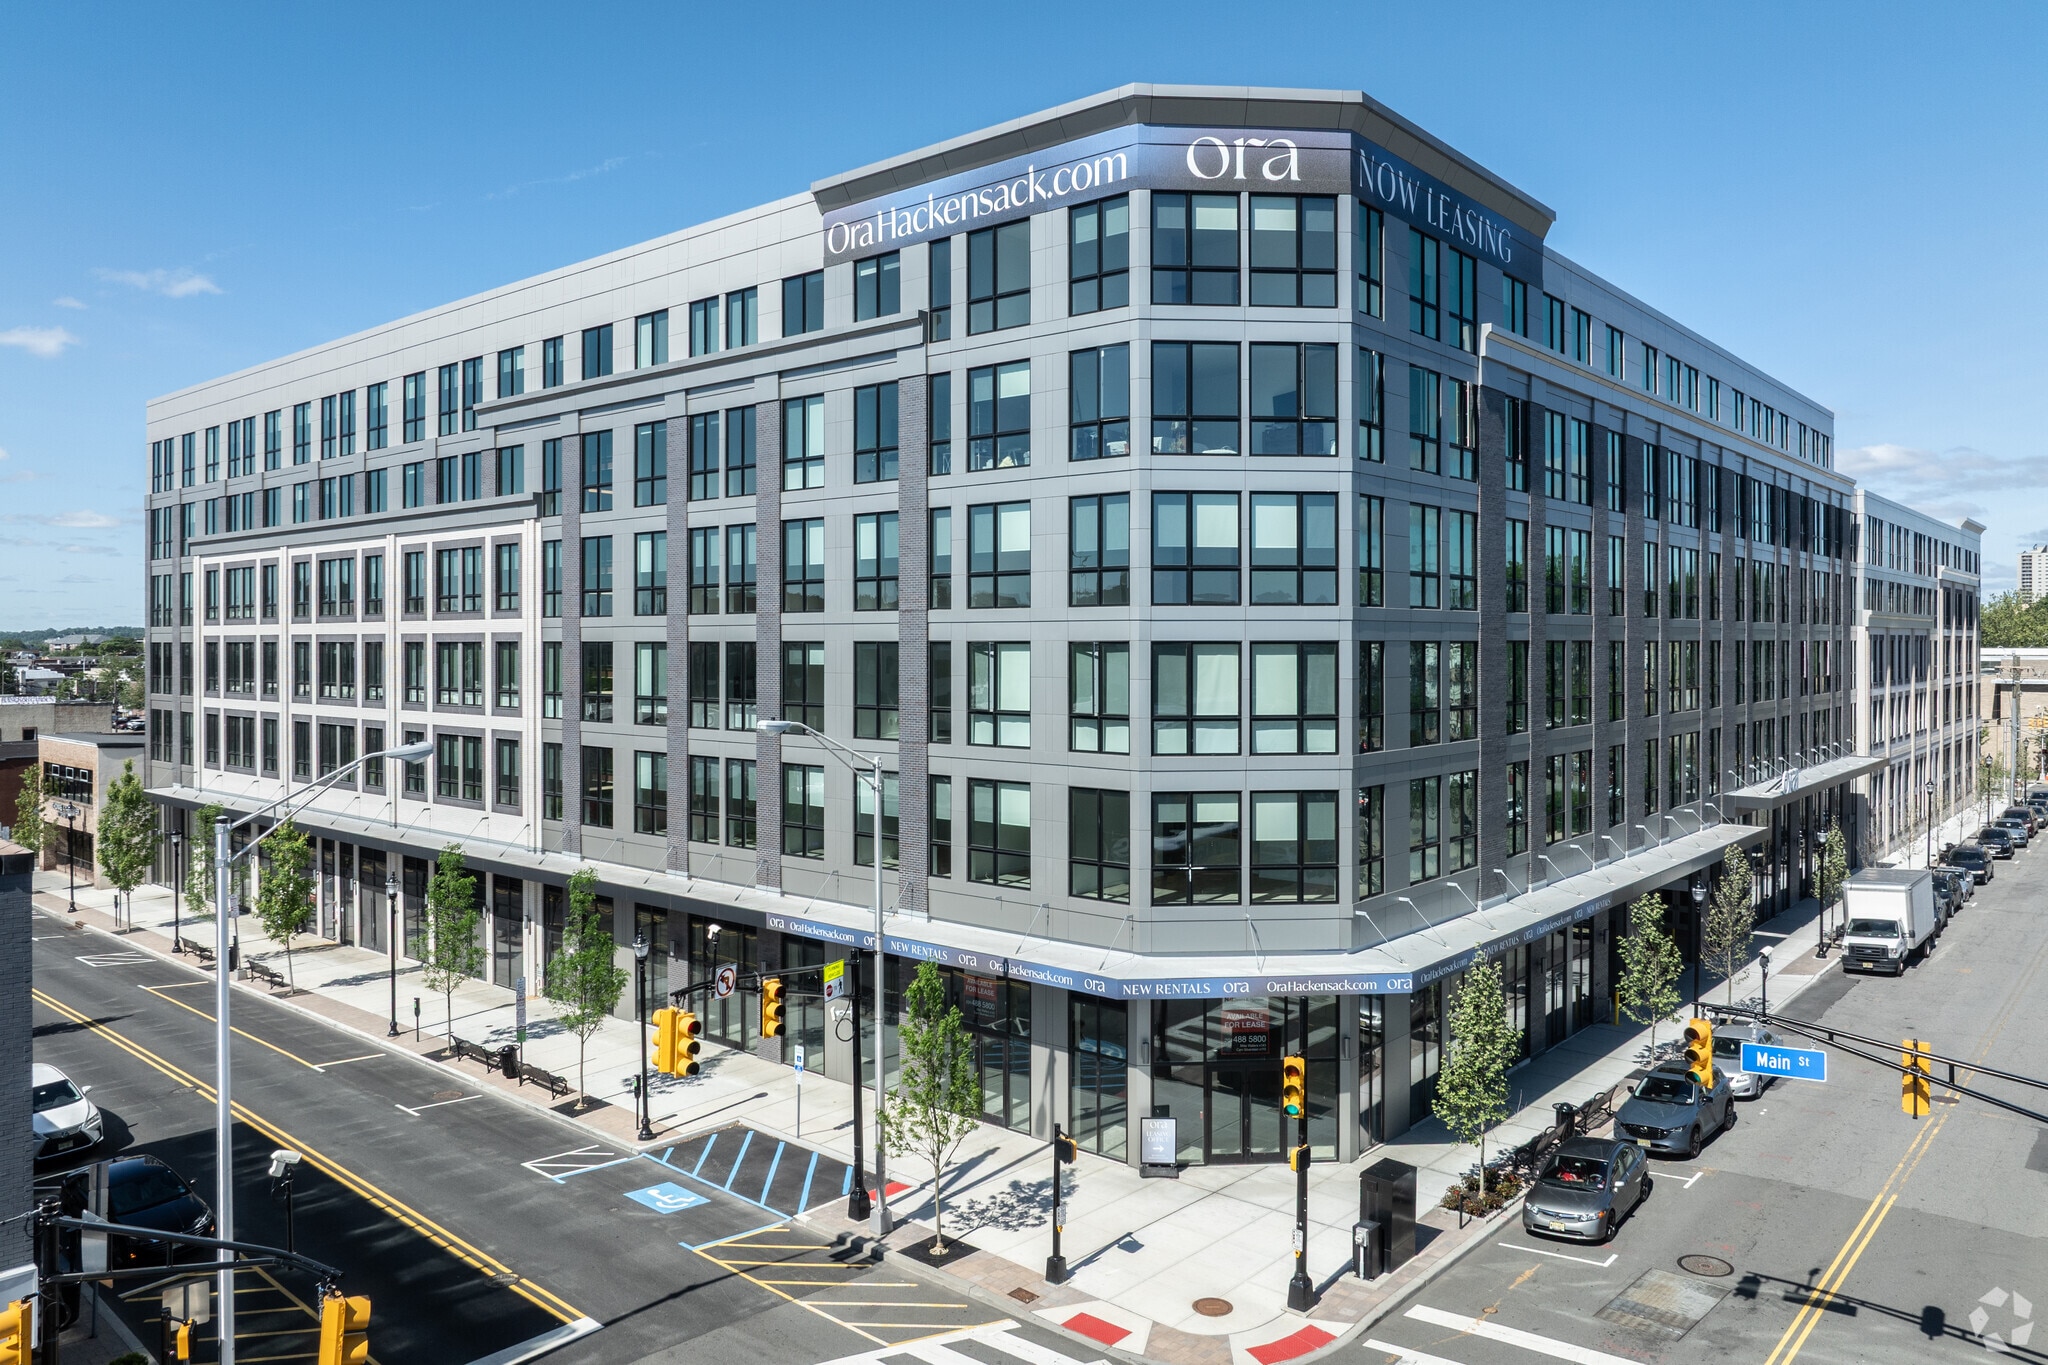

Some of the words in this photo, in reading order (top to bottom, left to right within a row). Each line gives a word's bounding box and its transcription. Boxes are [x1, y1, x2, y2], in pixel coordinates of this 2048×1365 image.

[1186, 136, 1301, 181] ora
[1359, 149, 1420, 215] NOW
[1427, 187, 1512, 264] LEASING
[769, 917, 785, 930] ora
[863, 935, 876, 947] or
[890, 940, 910, 952] NEW
[911, 944, 948, 960] RENTALS
[958, 953, 977, 967] ora
[1084, 978, 1105, 992] ora
[1122, 984, 1152, 995] NEW
[1155, 982, 1211, 994] RENTALS
[1223, 981, 1250, 993] ora
[1386, 978, 1413, 990] ora
[1226, 1012, 1264, 1020] AVAILABLE
[1233, 1035, 1247, 1043] 488
[1756, 1051, 1790, 1070] Main
[1798, 1056, 1810, 1067] St
